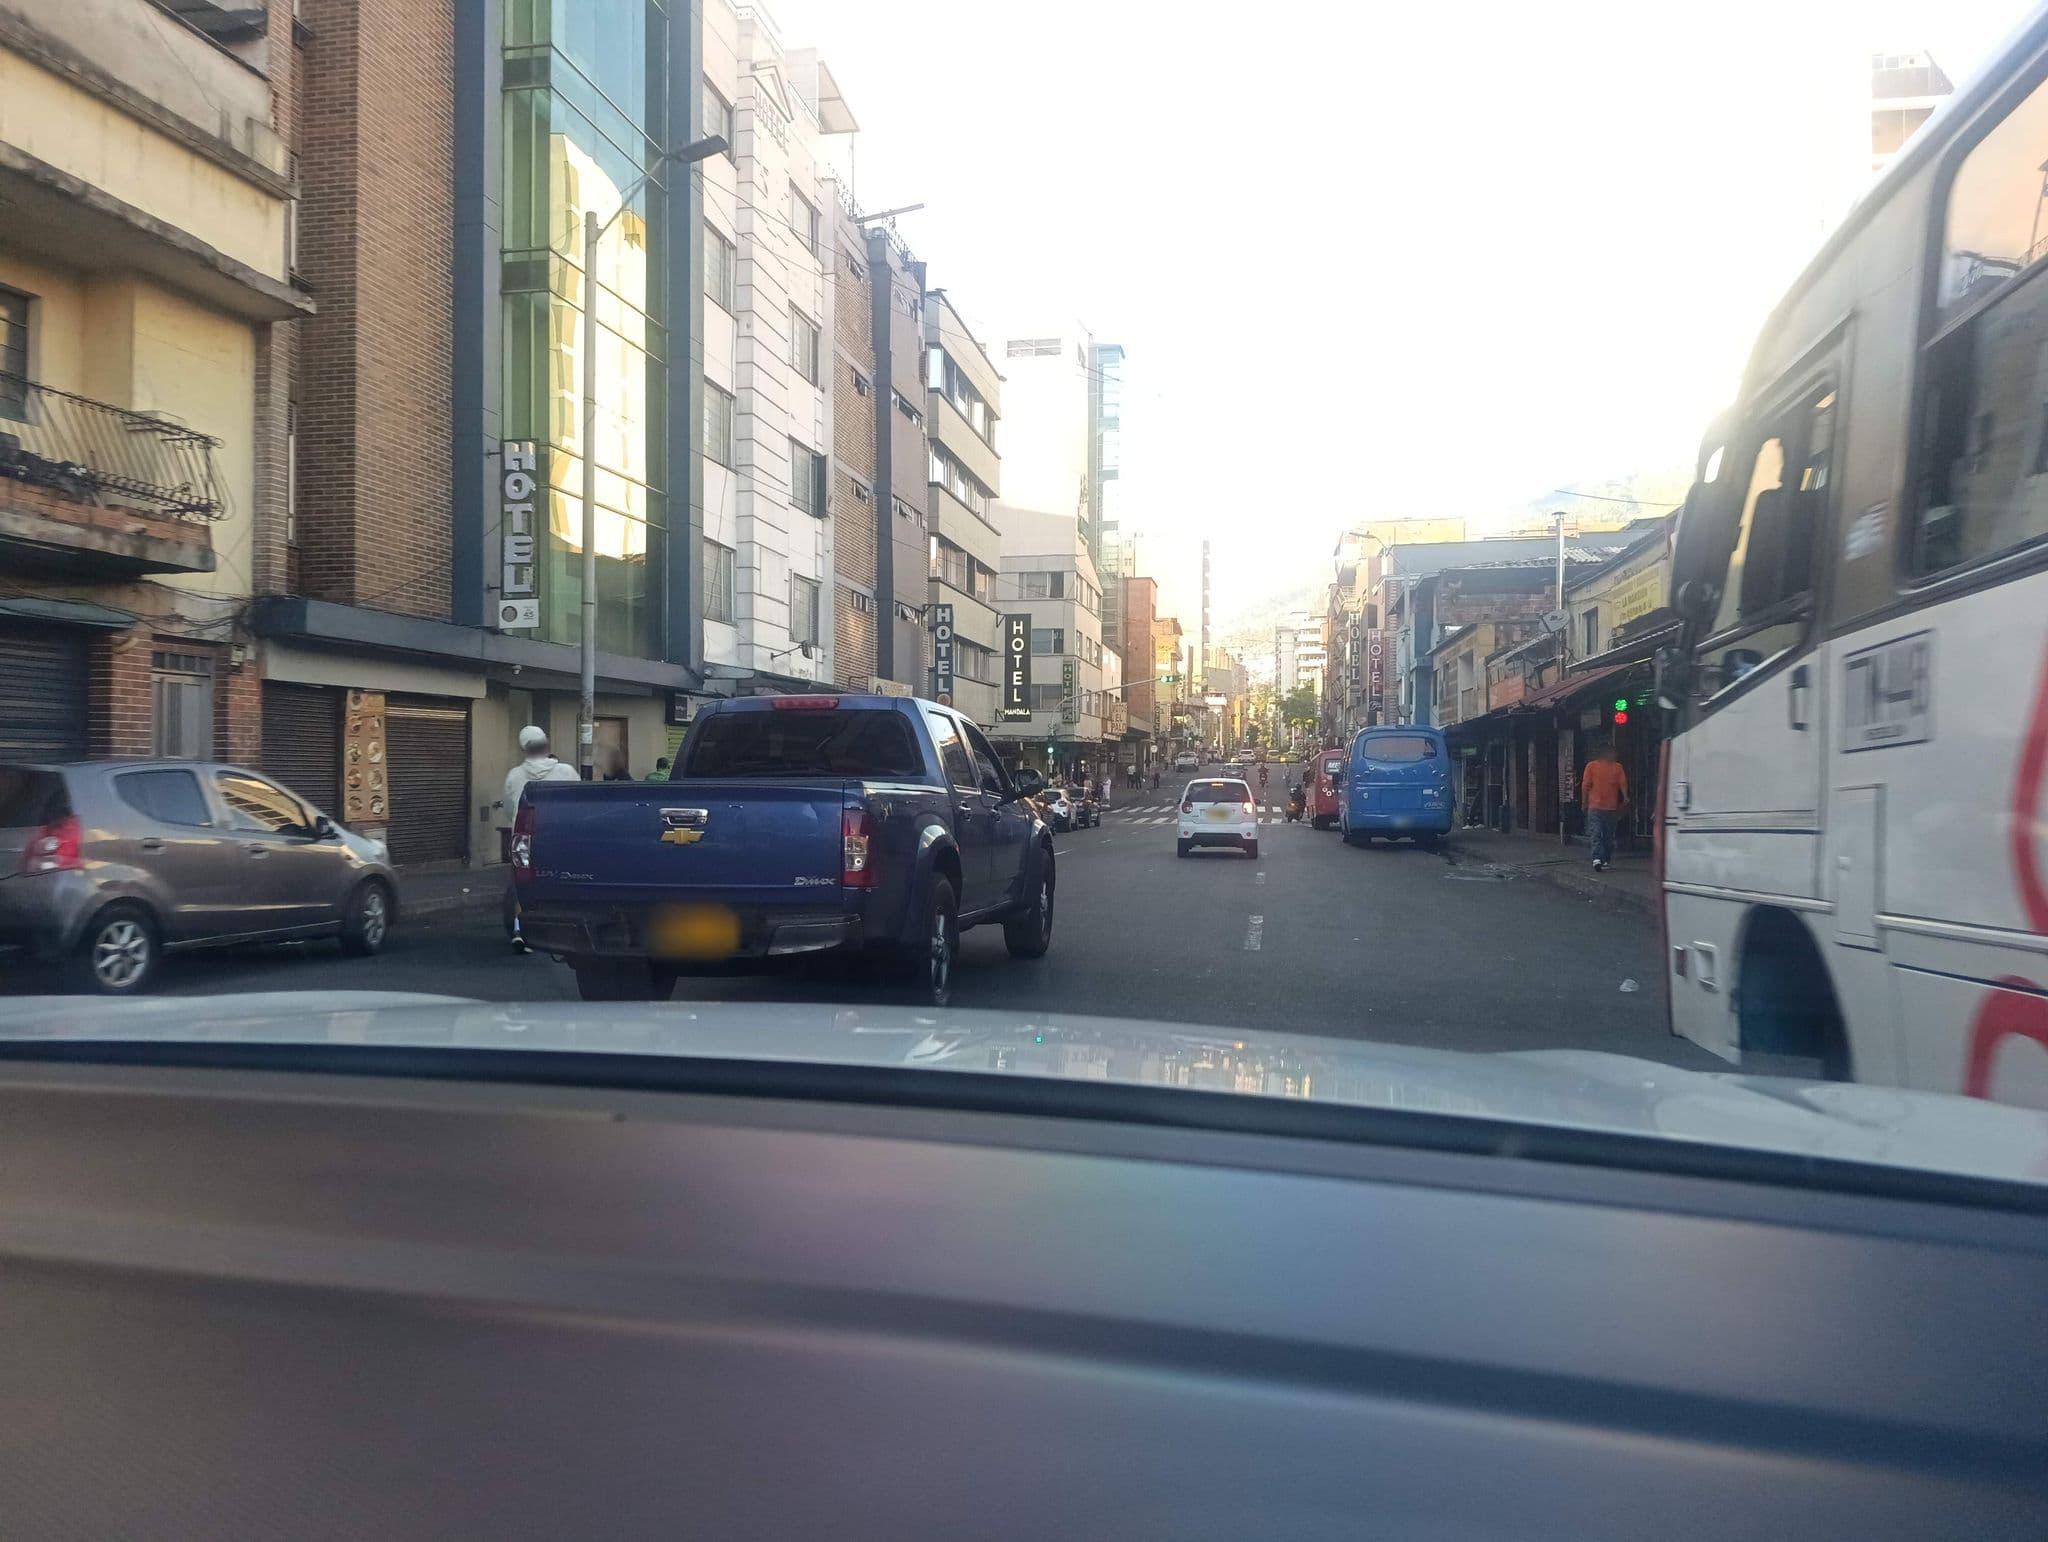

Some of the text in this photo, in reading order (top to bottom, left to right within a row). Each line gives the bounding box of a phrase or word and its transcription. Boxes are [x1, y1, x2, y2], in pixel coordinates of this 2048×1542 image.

[503, 441, 537, 594] HOTEL
[935, 606, 951, 693] HOTEL
[1011, 620, 1025, 703] HOTEL
[1349, 613, 1360, 681] HOTEL
[1370, 630, 1382, 697] HOTEL
